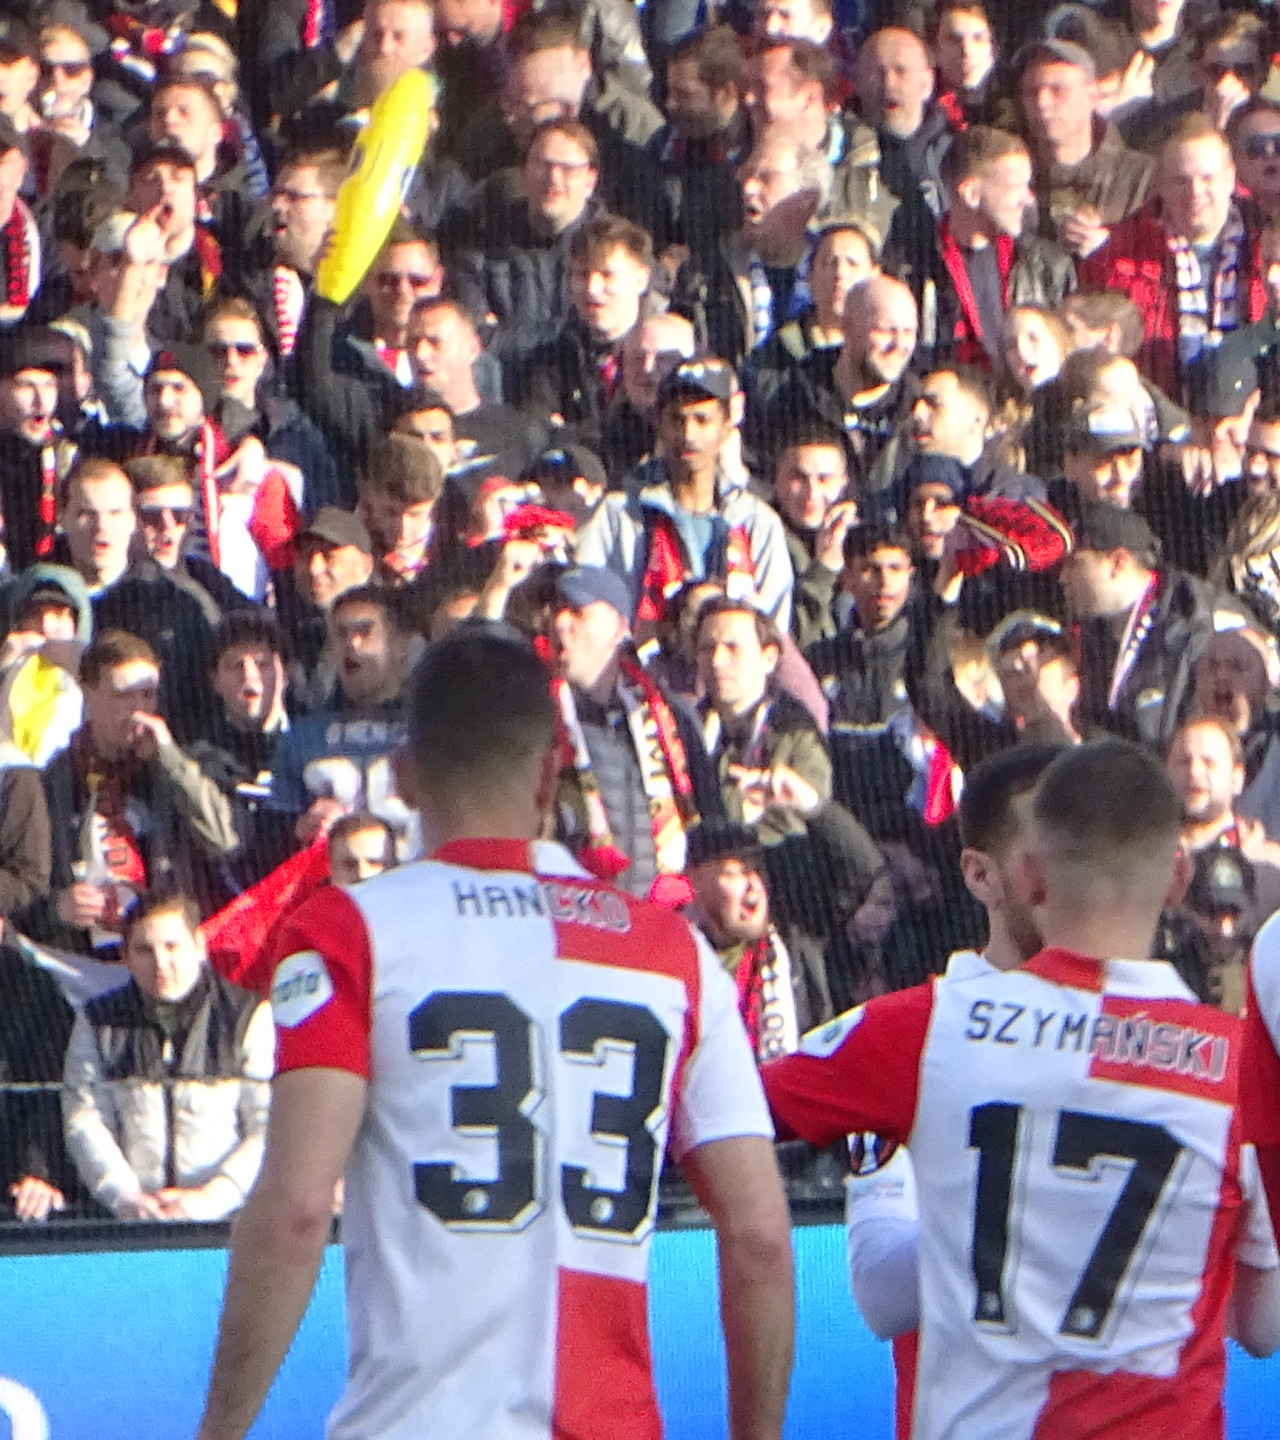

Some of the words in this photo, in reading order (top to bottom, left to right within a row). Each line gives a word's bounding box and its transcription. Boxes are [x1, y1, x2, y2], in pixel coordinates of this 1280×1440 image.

[407, 990, 675, 1245] 33
[965, 1000, 1231, 1084] SZYMAŃSKI
[967, 1101, 1195, 1347] 17
